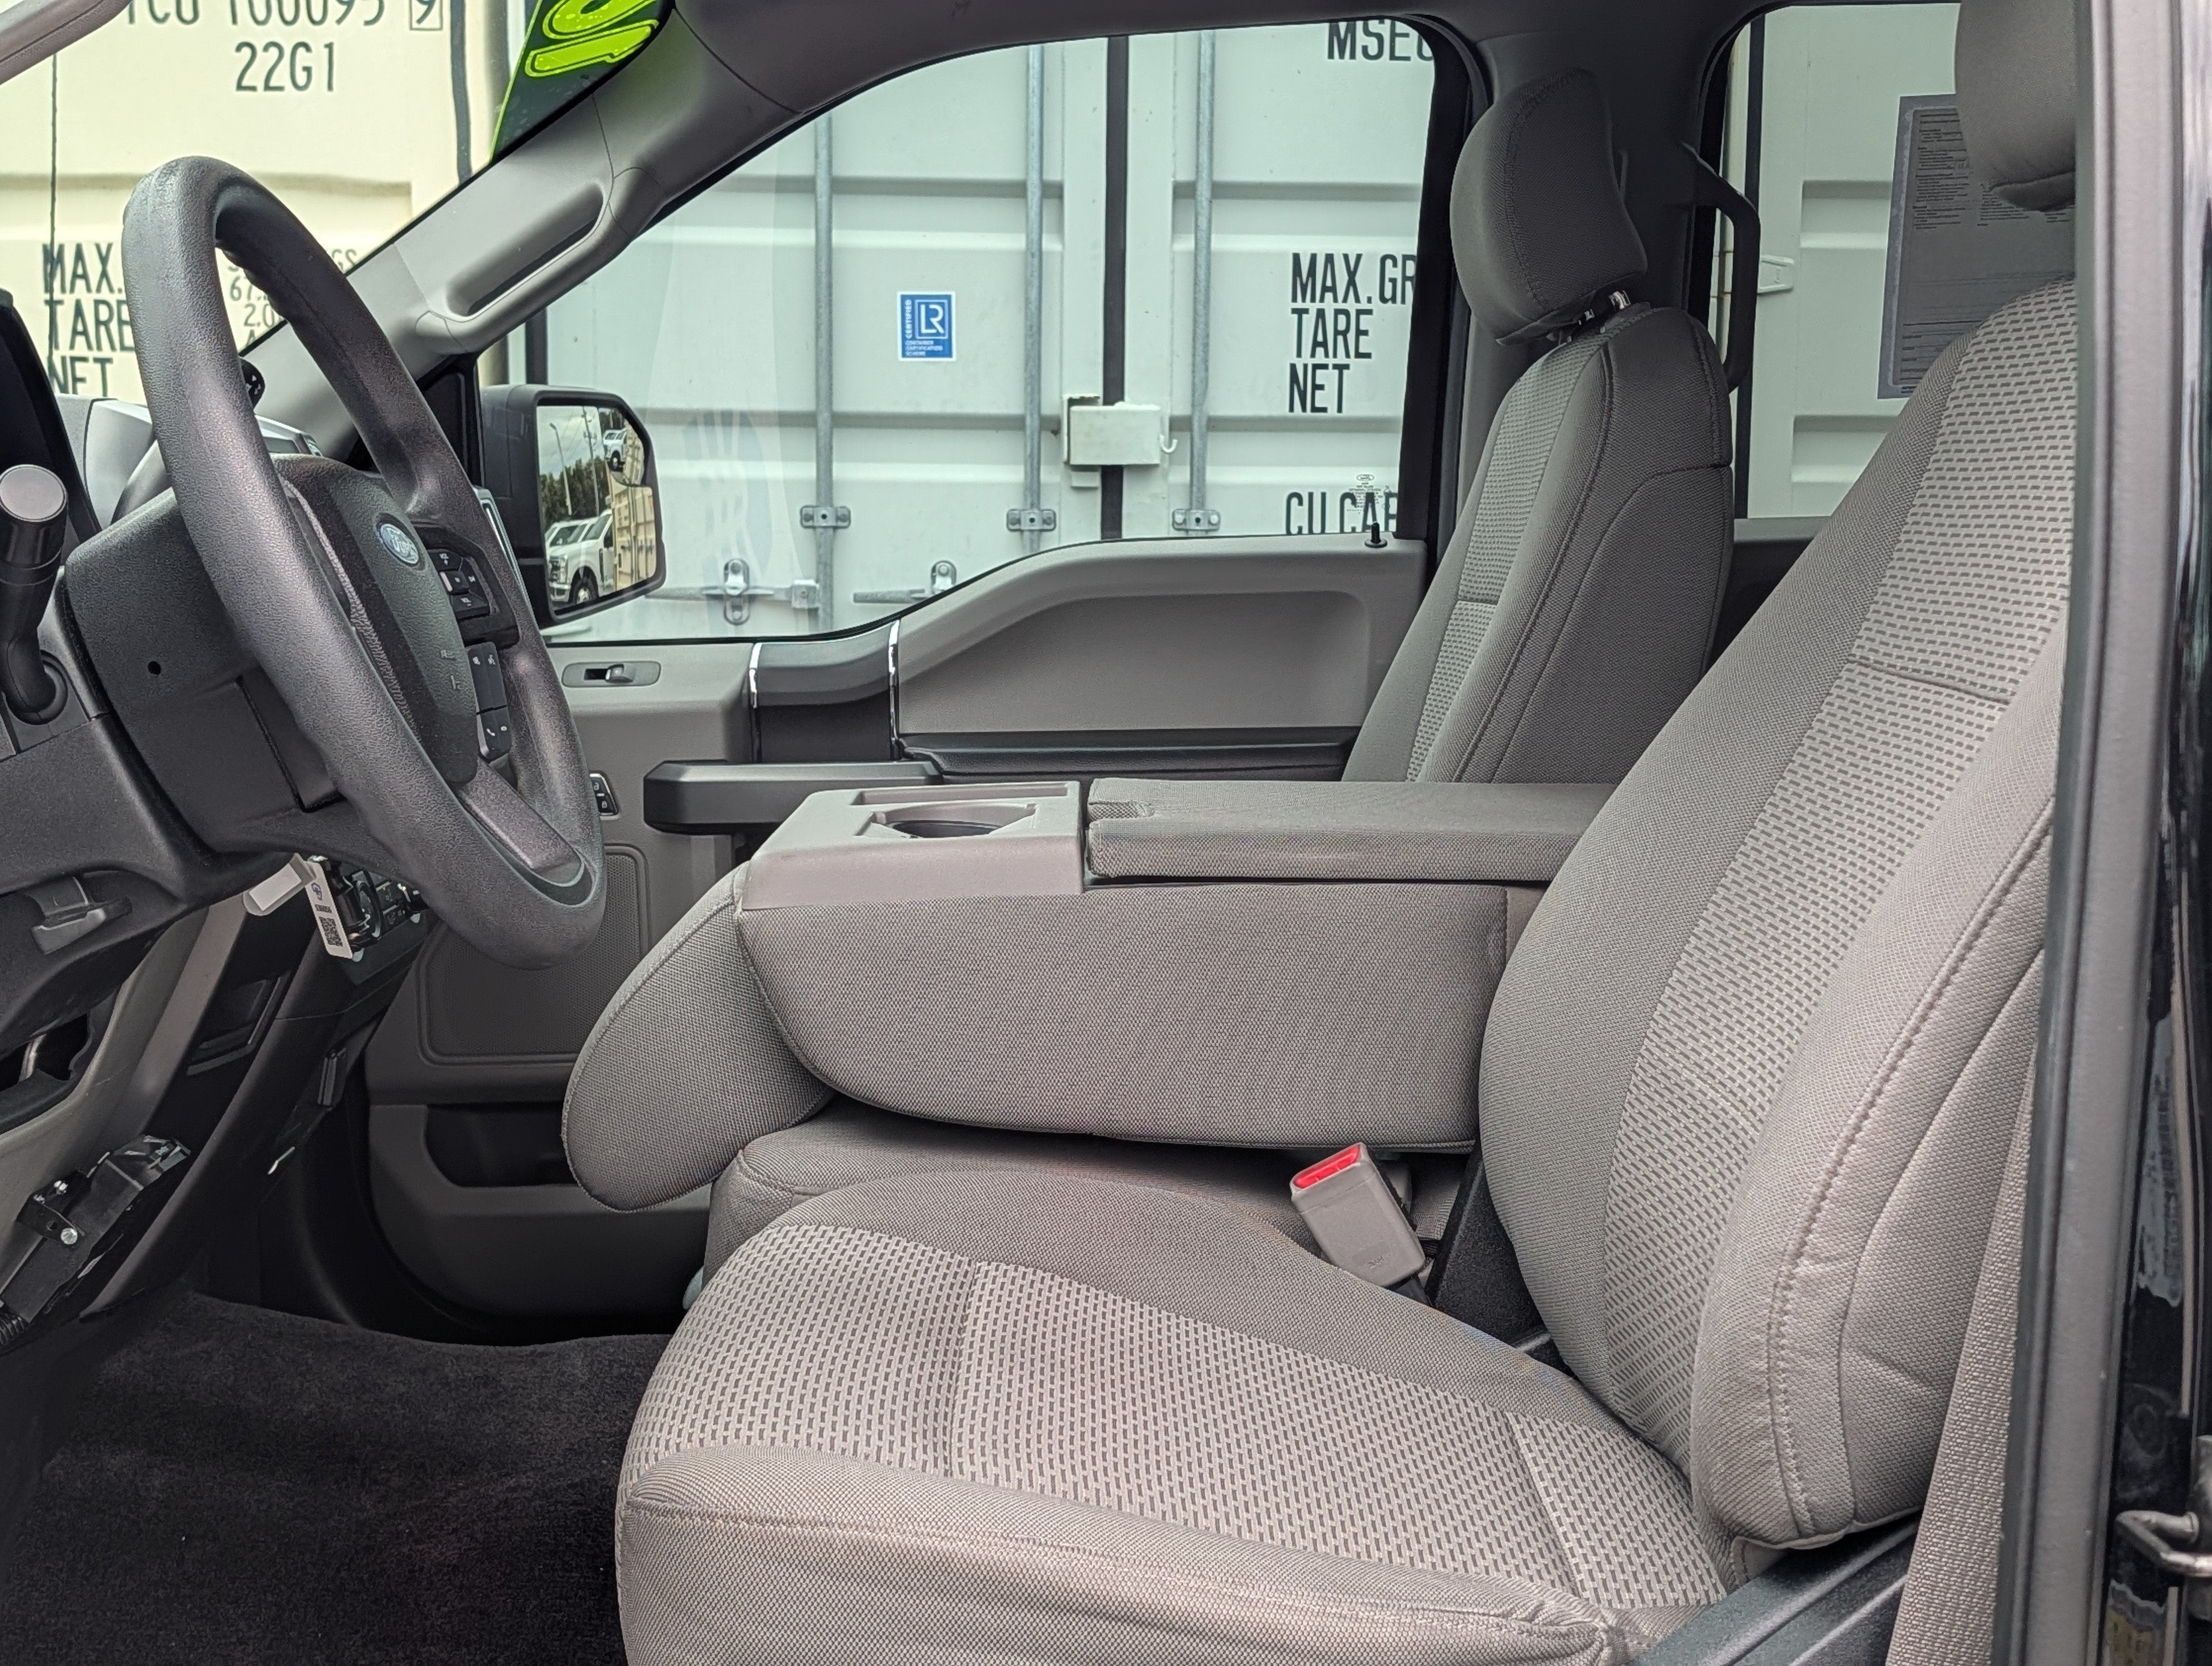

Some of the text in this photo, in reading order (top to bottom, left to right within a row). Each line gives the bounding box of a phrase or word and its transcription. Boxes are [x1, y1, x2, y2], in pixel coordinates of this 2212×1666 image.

[235, 41, 335, 92] 22G1
[42, 242, 124, 294] MAX.
[44, 299, 136, 352] TARE
[920, 304, 944, 334] LR
[1291, 307, 1373, 358] TARE
[47, 355, 113, 397] NET
[1288, 363, 1350, 413] NET
